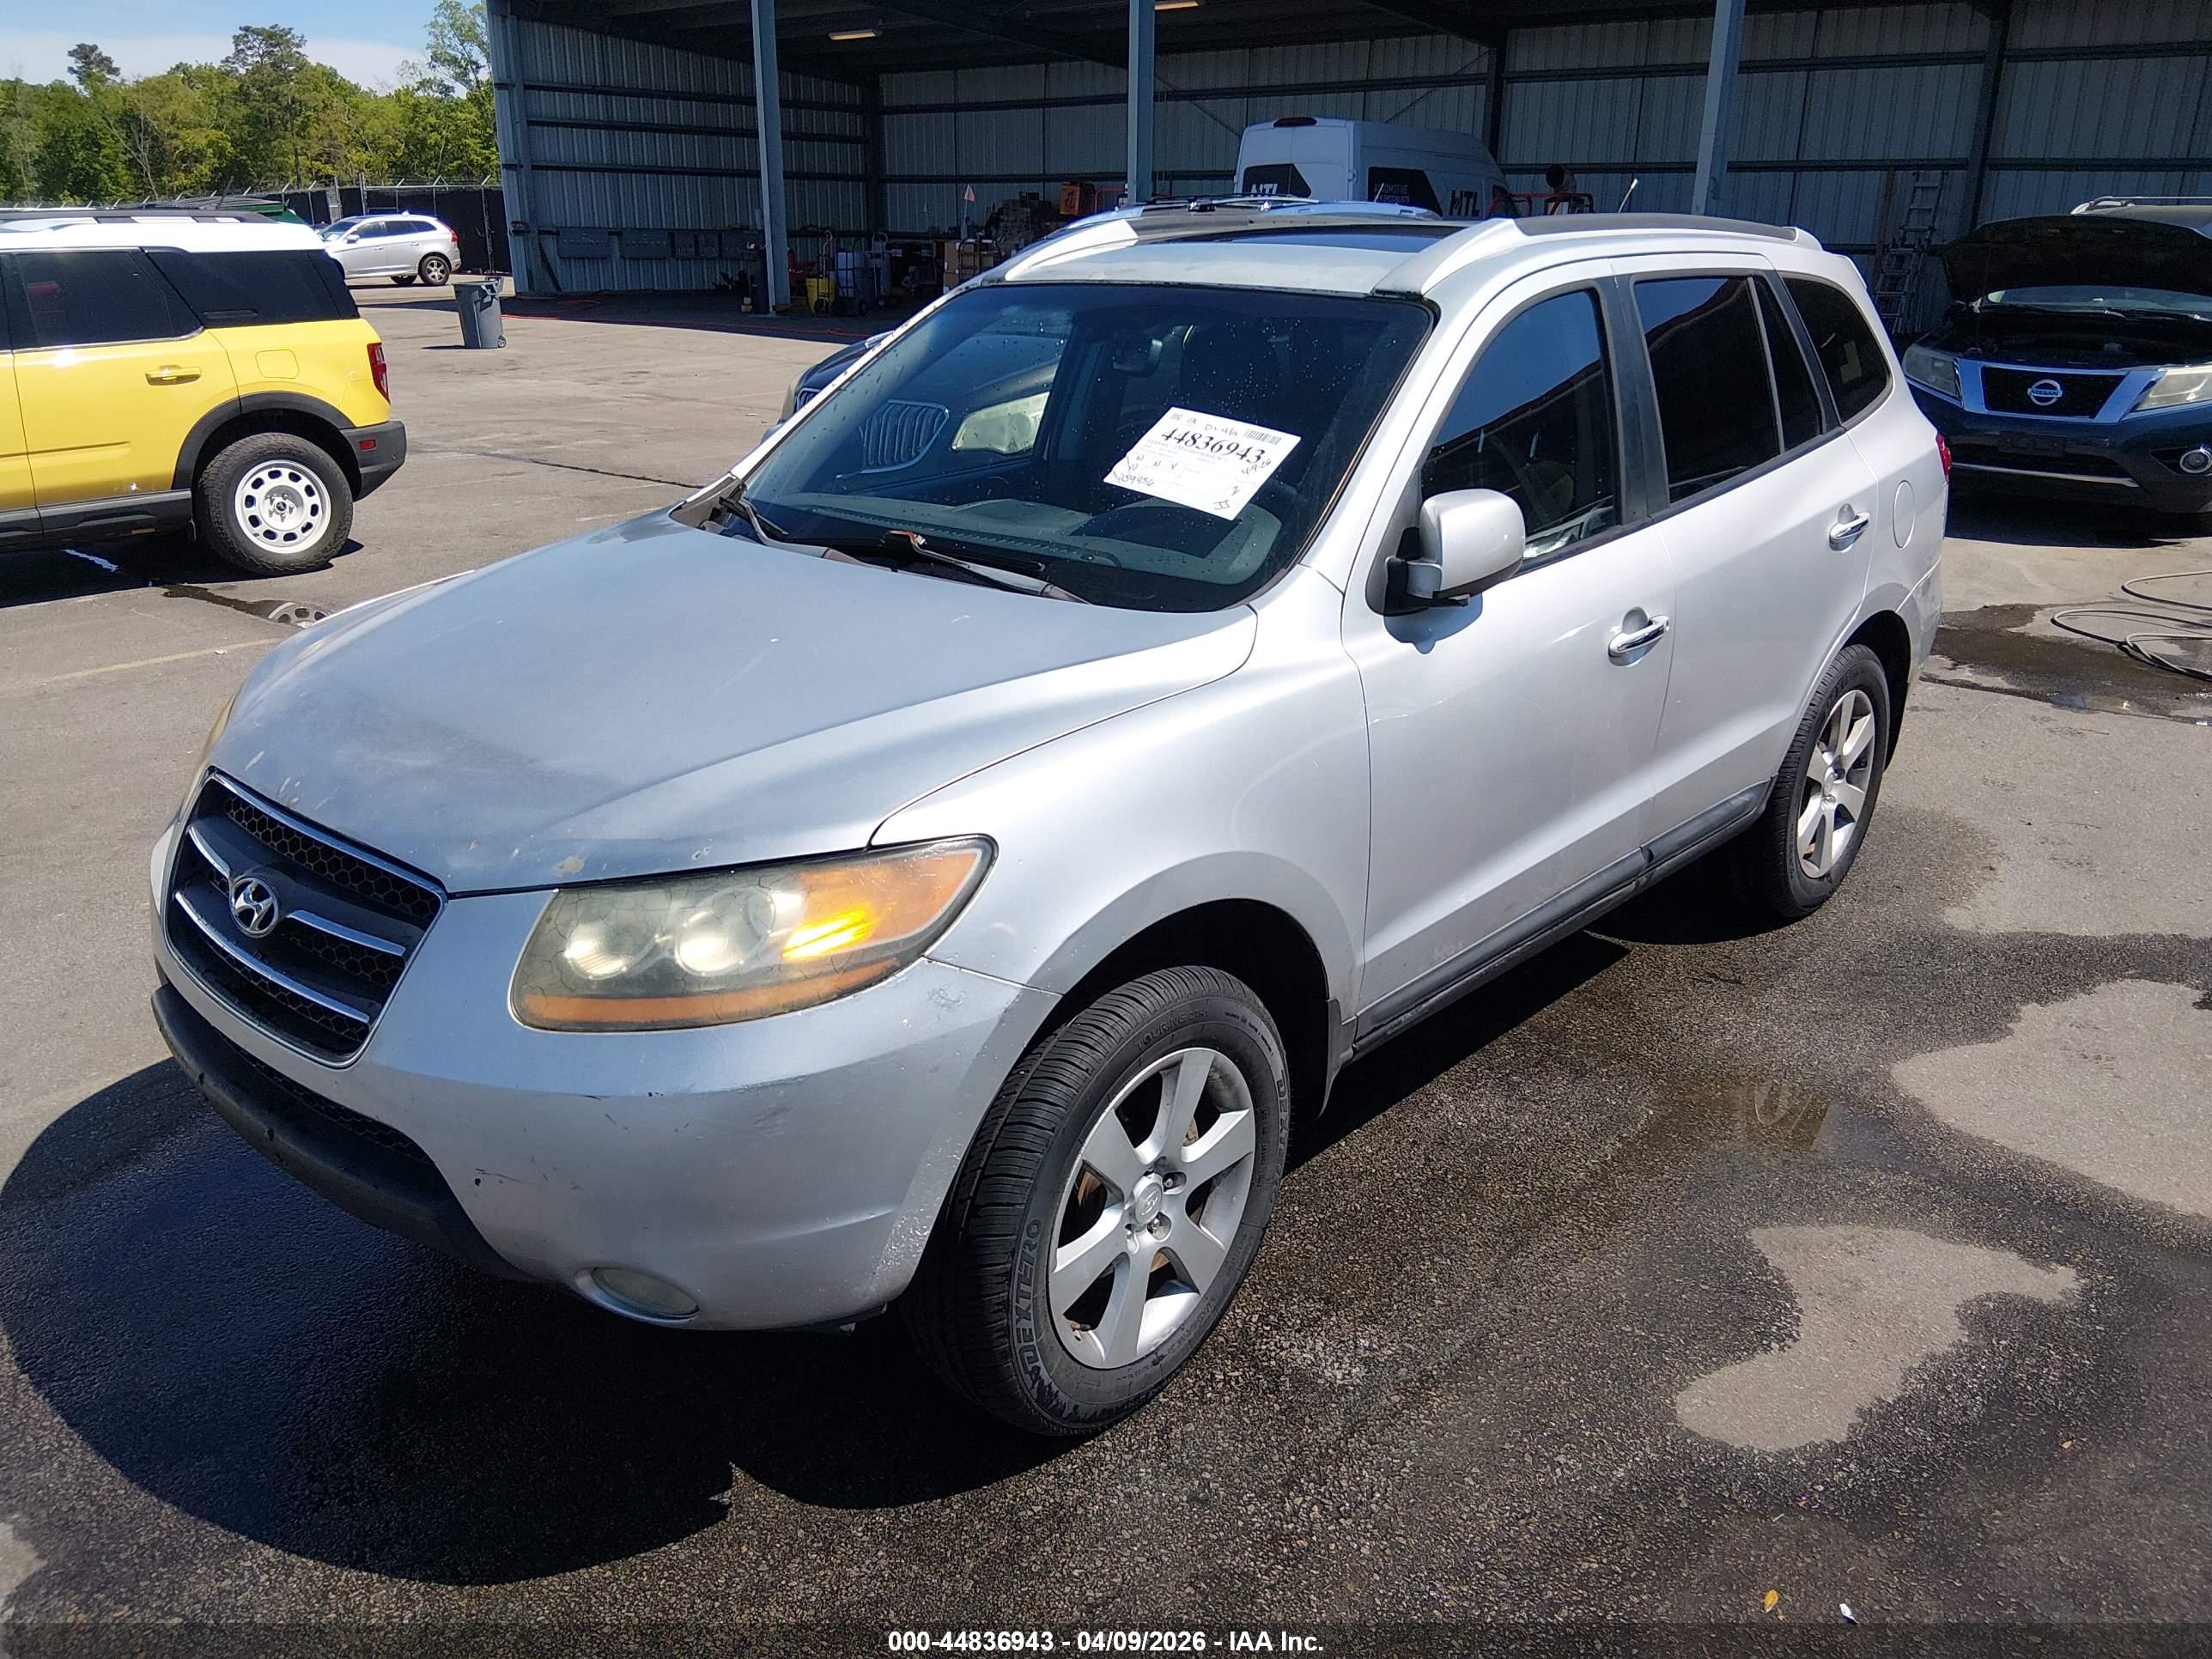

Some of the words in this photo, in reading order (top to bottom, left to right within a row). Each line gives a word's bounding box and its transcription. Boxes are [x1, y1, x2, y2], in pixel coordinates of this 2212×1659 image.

[1449, 189, 1480, 217] MTL
[1162, 428, 1265, 463] 44836943
[1014, 1218, 1042, 1374] DEXTERO
